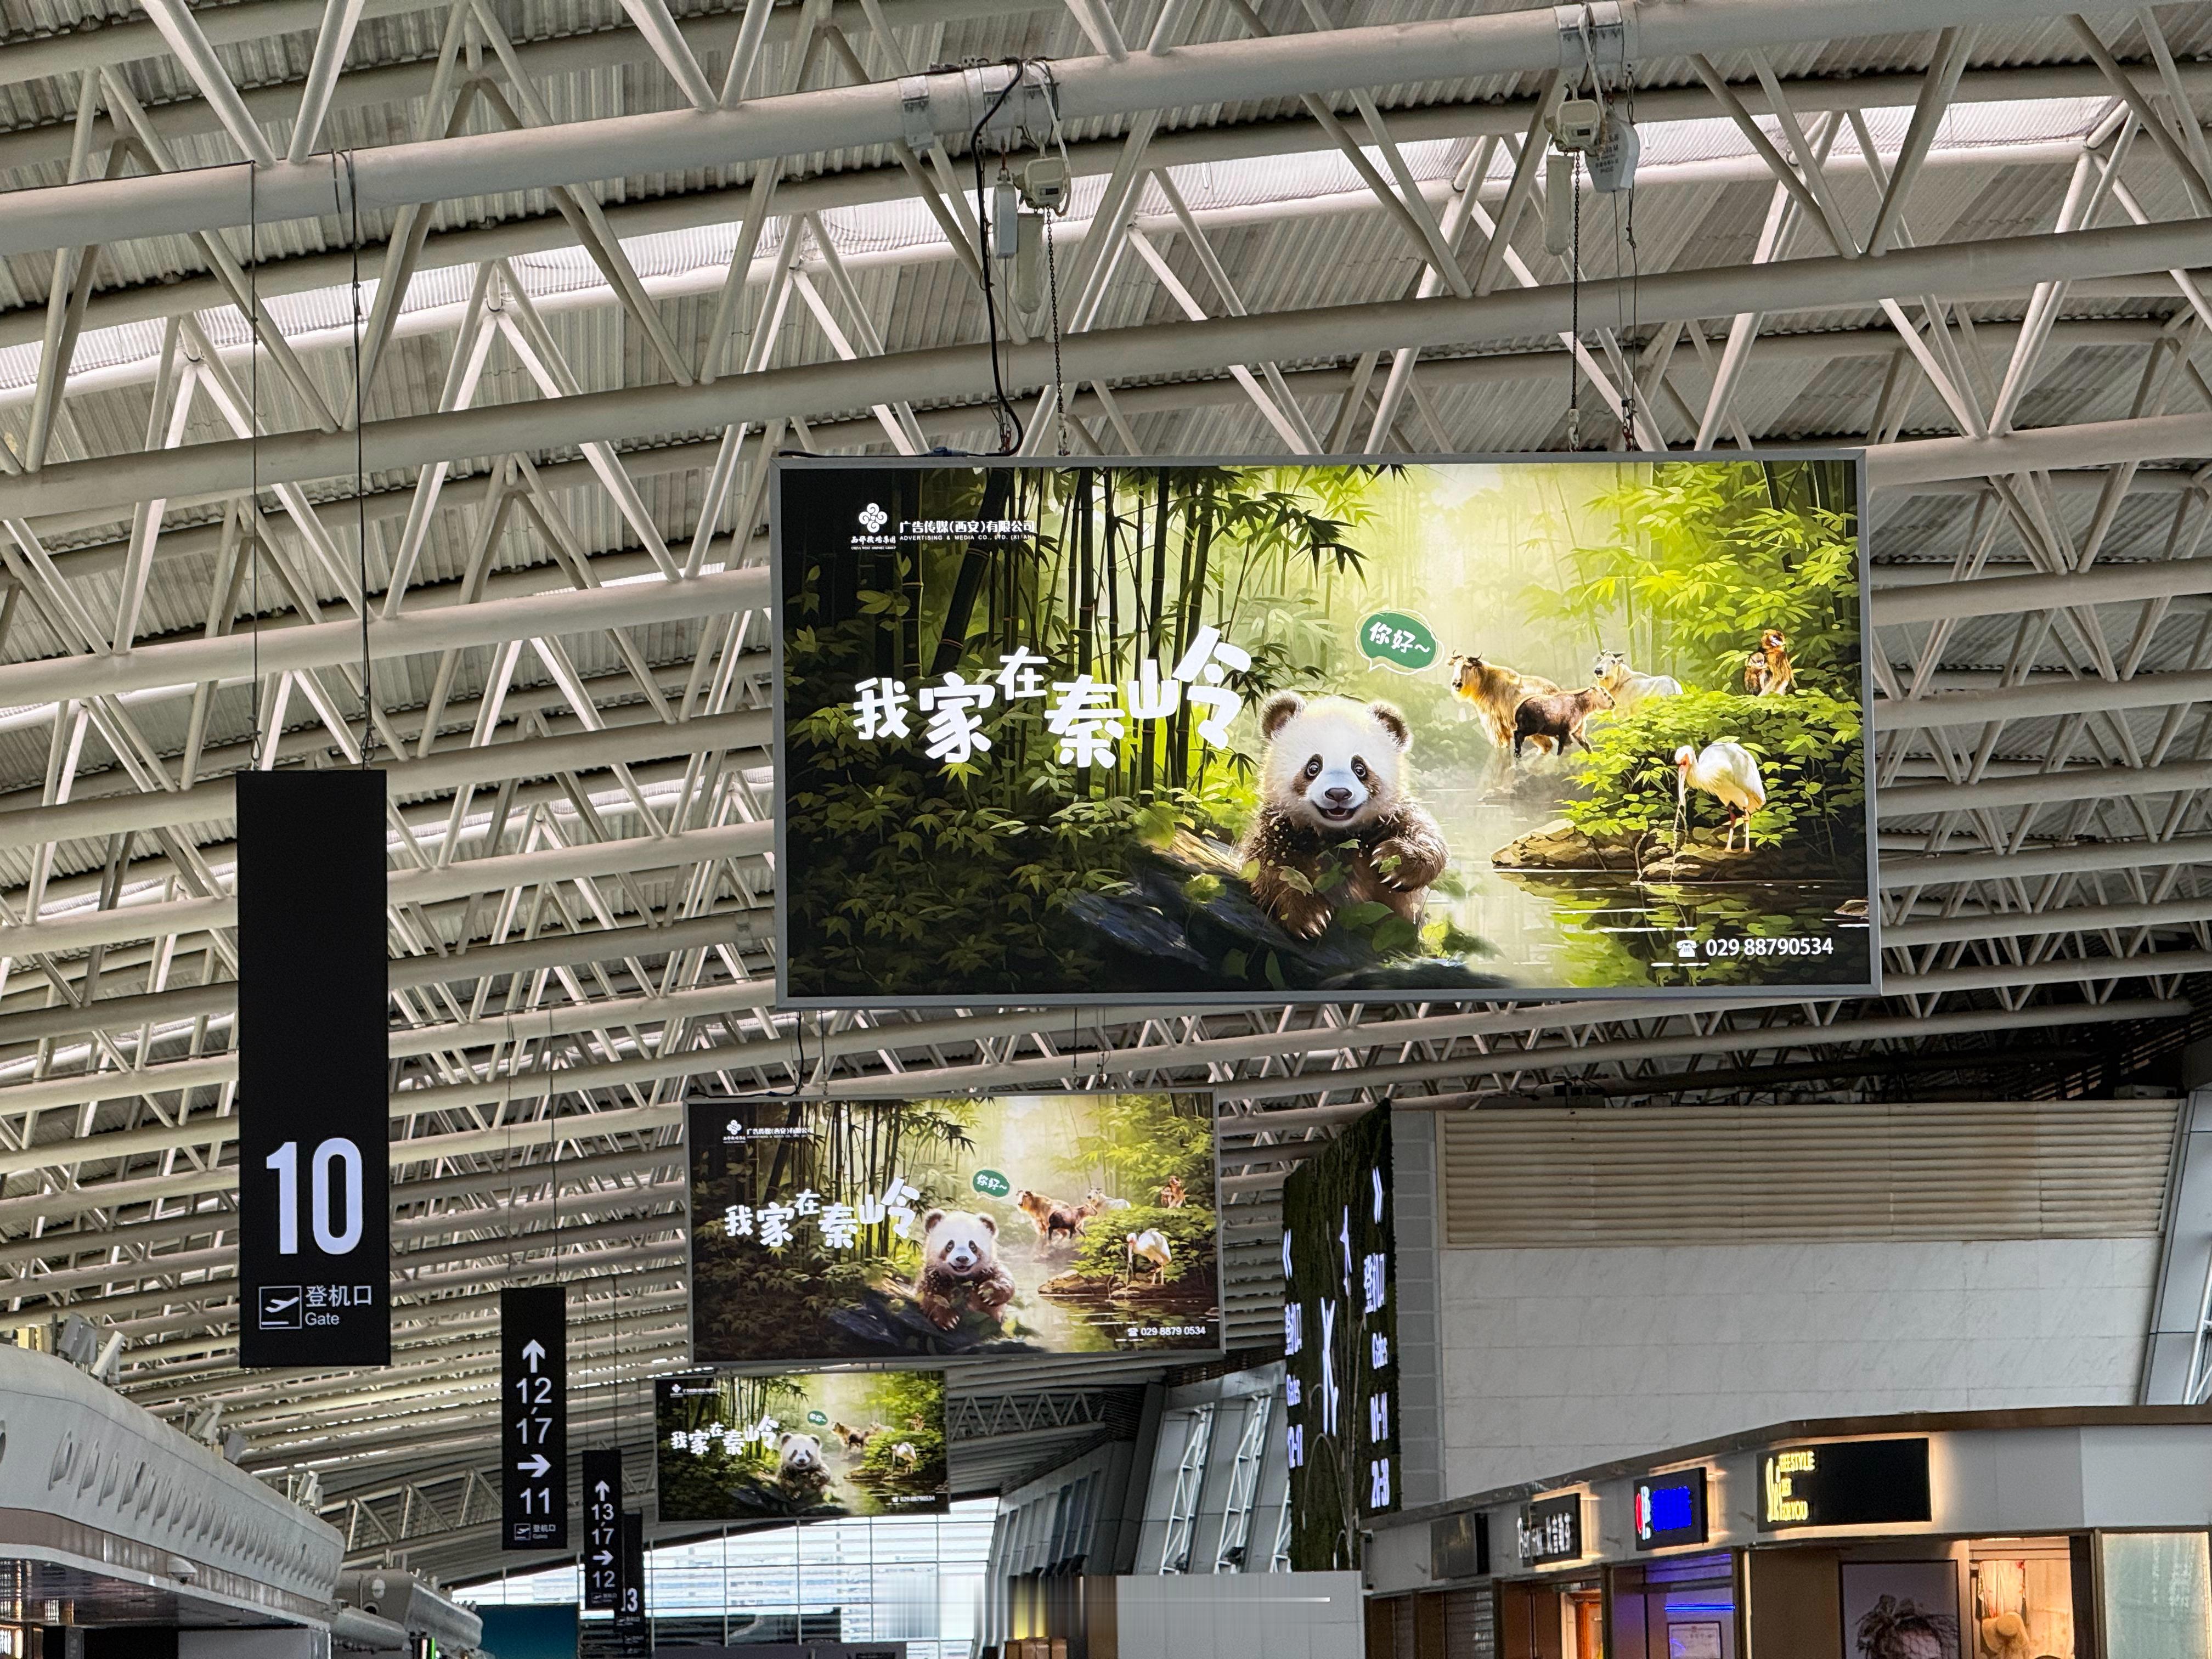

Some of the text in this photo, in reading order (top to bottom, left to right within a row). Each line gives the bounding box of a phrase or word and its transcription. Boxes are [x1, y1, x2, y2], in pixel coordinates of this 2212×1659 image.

[853, 625, 1251, 768] 我家在秦岭
[1706, 938, 1834, 956] 029 88790534
[266, 1137, 363, 1255] 10
[724, 1177, 921, 1249] 我家在秦岭
[306, 1284, 371, 1307] 登机口
[304, 1312, 340, 1325] Gate
[1141, 1325, 1206, 1336] 029 8879 0534
[516, 1377, 552, 1404] 12
[516, 1418, 552, 1444] 17
[670, 1415, 779, 1455] 我家在秦岭
[520, 1487, 550, 1514] 11
[591, 1503, 614, 1520] 13
[591, 1528, 614, 1545] 17
[592, 1570, 615, 1588] 12
